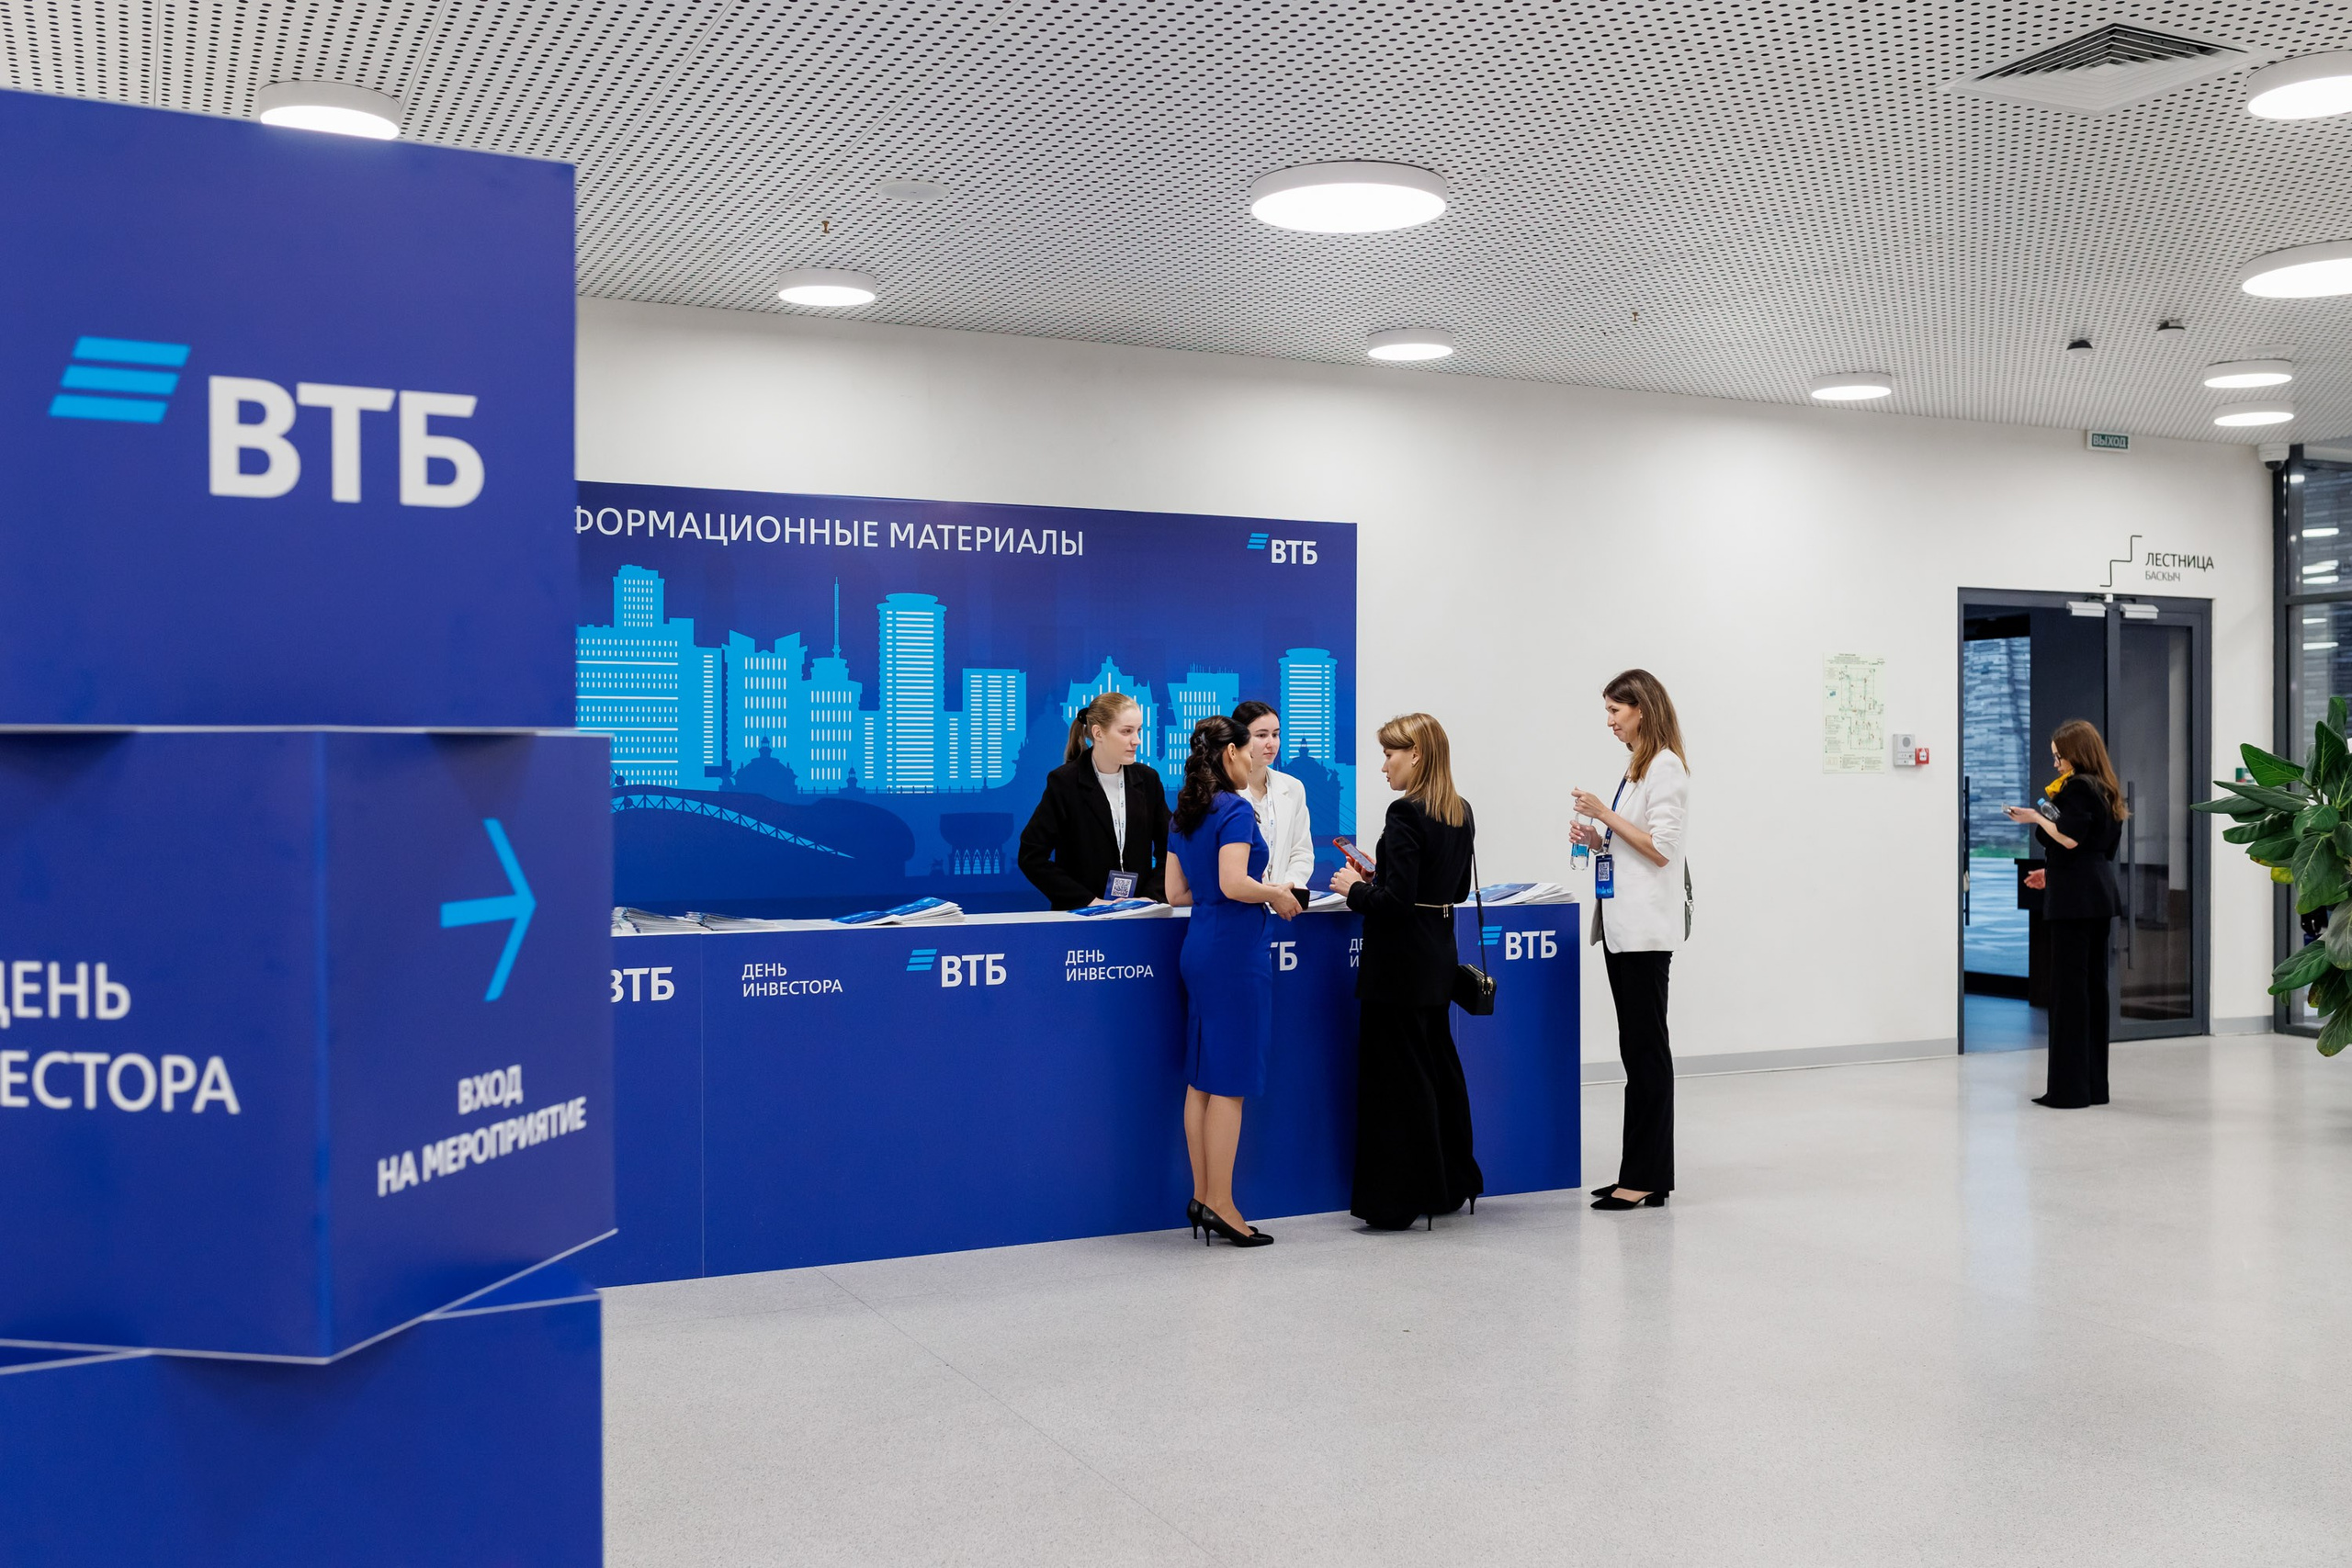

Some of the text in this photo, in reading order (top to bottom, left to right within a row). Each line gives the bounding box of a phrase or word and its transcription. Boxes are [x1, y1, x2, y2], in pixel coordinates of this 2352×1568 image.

[209, 375, 485, 508] ВТБ
[2093, 434, 2126, 448] ВЫХОД
[889, 522, 1083, 556] МАТЕРИАЛЫ
[1271, 539, 1318, 565] ВТБ
[2145, 552, 2214, 572] ЛЕСТНИЦА
[2145, 570, 2181, 581] БАСКЫЧ
[1066, 949, 1105, 965] ДЕНЬ
[1505, 930, 1558, 961] ВТБ
[741, 963, 787, 981] ДЕНЬ
[941, 953, 1007, 988] ВТБ
[1066, 964, 1154, 982] ИНВЕСТОРА
[742, 978, 843, 998] ИНВЕСТОРА
[458, 1064, 524, 1115] ВХОД
[378, 1096, 587, 1198] НА МЕРОПРИЯТИЕ
